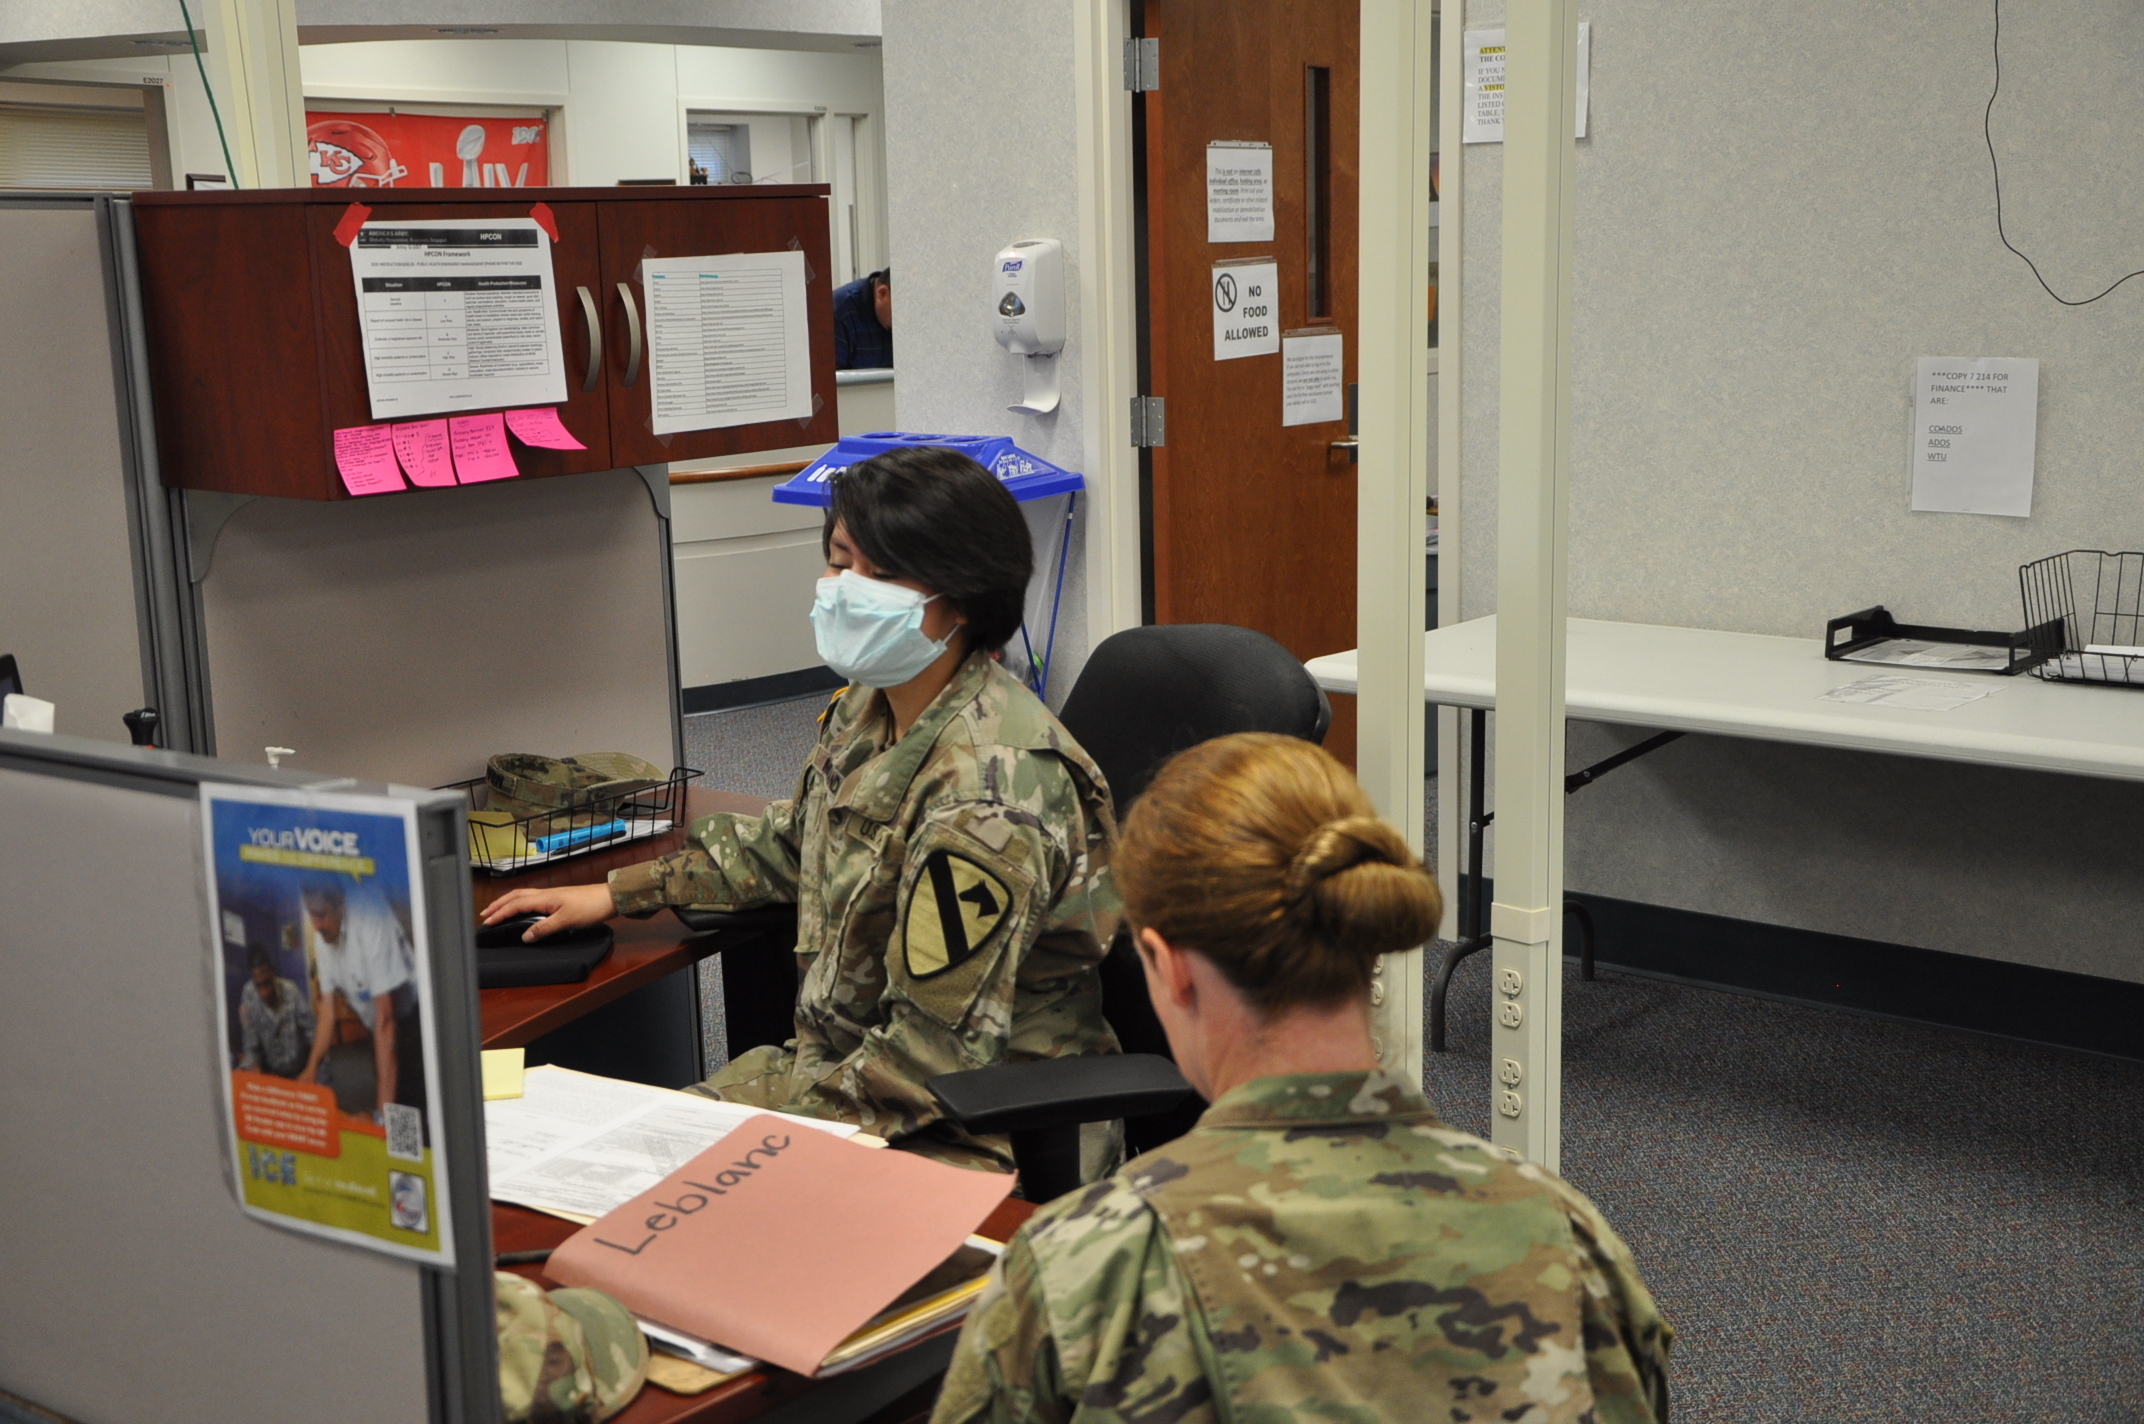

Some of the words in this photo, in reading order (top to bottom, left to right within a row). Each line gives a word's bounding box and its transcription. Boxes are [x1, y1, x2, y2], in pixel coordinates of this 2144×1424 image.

[1480, 55, 1494, 63] THE
[1486, 67, 1500, 75] YOU
[1478, 93, 1491, 101] THE
[1492, 92, 1504, 100] INS
[1477, 101, 1501, 109] LISTED
[1477, 118, 1500, 126] THANK
[319, 150, 351, 175] KC
[480, 233, 502, 241] HPCON
[1248, 285, 1262, 297] NO
[1243, 305, 1268, 318] FOOD
[1225, 325, 1269, 341] ALLOWED
[1976, 373, 1991, 381] 214
[1993, 373, 2009, 381] FOR
[1930, 397, 1949, 405] ARE:
[1928, 439, 1951, 447] ADOS
[1927, 452, 1947, 461] WTU
[860, 818, 880, 840] U.S
[592, 1134, 791, 1256] Leblanc
